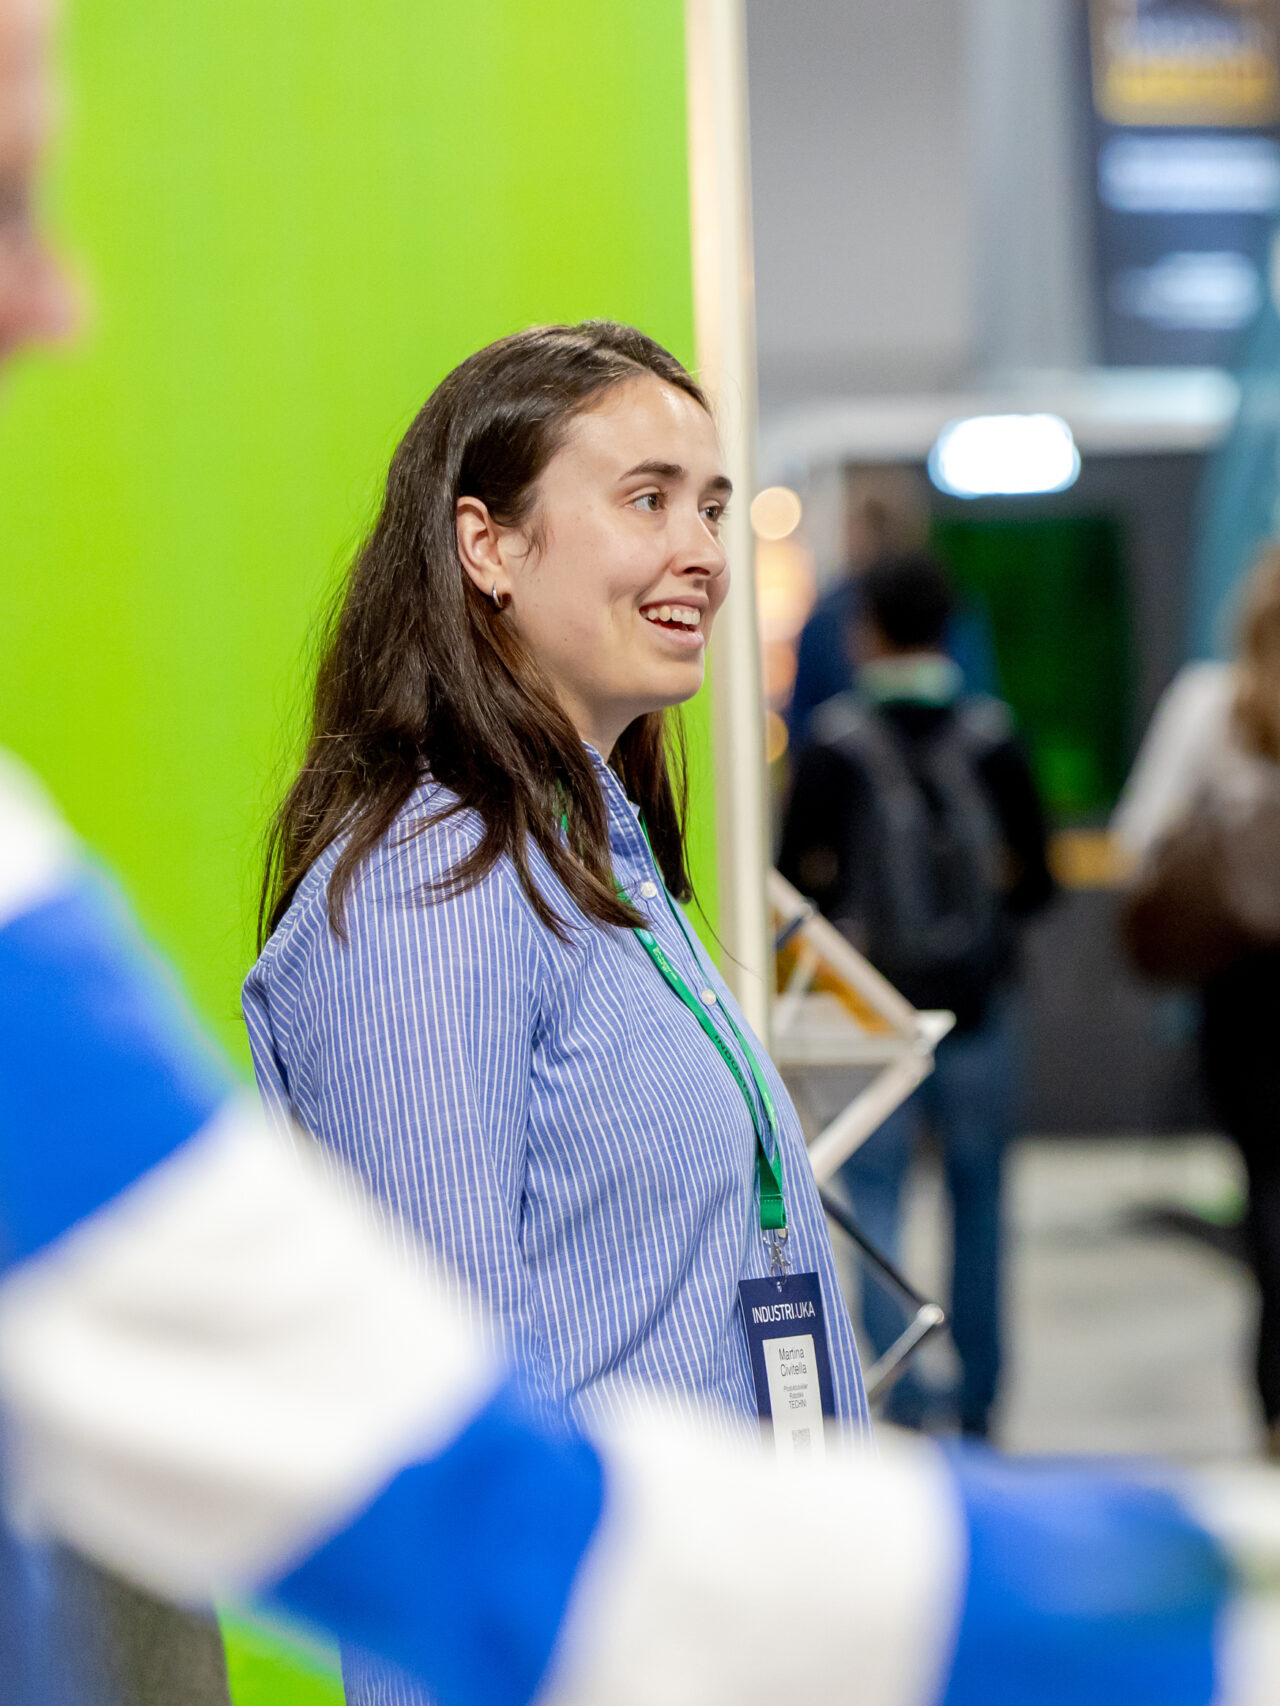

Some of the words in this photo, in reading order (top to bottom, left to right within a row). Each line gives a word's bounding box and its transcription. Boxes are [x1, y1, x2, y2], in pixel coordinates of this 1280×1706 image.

[751, 1301, 816, 1324] INDUSTRI.UKA
[779, 1348, 805, 1361] Martina
[780, 1363, 807, 1377] Civitella
